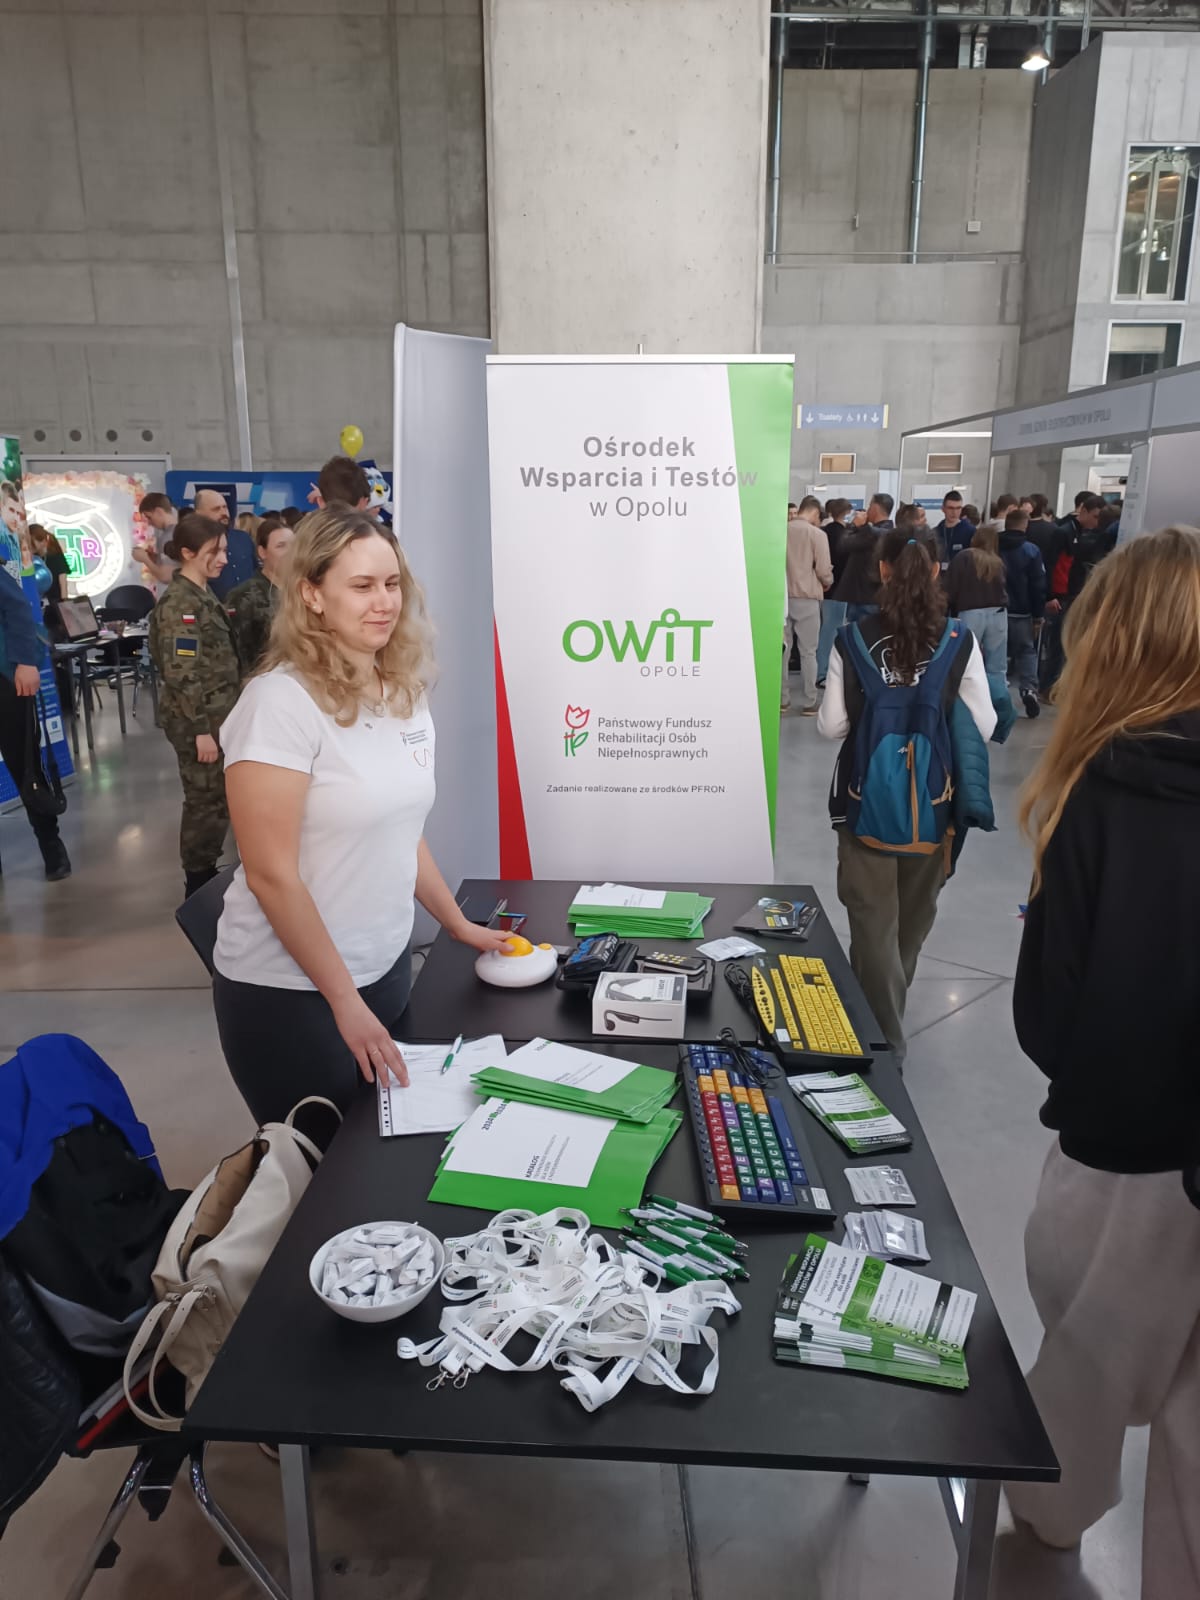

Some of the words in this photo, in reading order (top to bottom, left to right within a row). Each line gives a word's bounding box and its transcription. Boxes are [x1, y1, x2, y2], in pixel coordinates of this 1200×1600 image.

[583, 436, 696, 457] Ośrodek
[520, 466, 643, 492] Wsparcia
[651, 466, 657, 487] i
[665, 466, 759, 487] Testów
[590, 501, 608, 516] w
[615, 496, 688, 521] Opolu
[640, 665, 701, 677] OPOLE
[597, 716, 663, 731] Państwowy
[665, 716, 712, 728] Fundusz
[597, 732, 666, 745] Rehabilitacji
[668, 732, 697, 743] Osób
[597, 747, 708, 760] Niepełnosprawnych
[546, 784, 582, 793] Zadanie
[585, 784, 638, 793] realizowane
[652, 784, 689, 793] środków
[691, 784, 726, 793] PFRON
